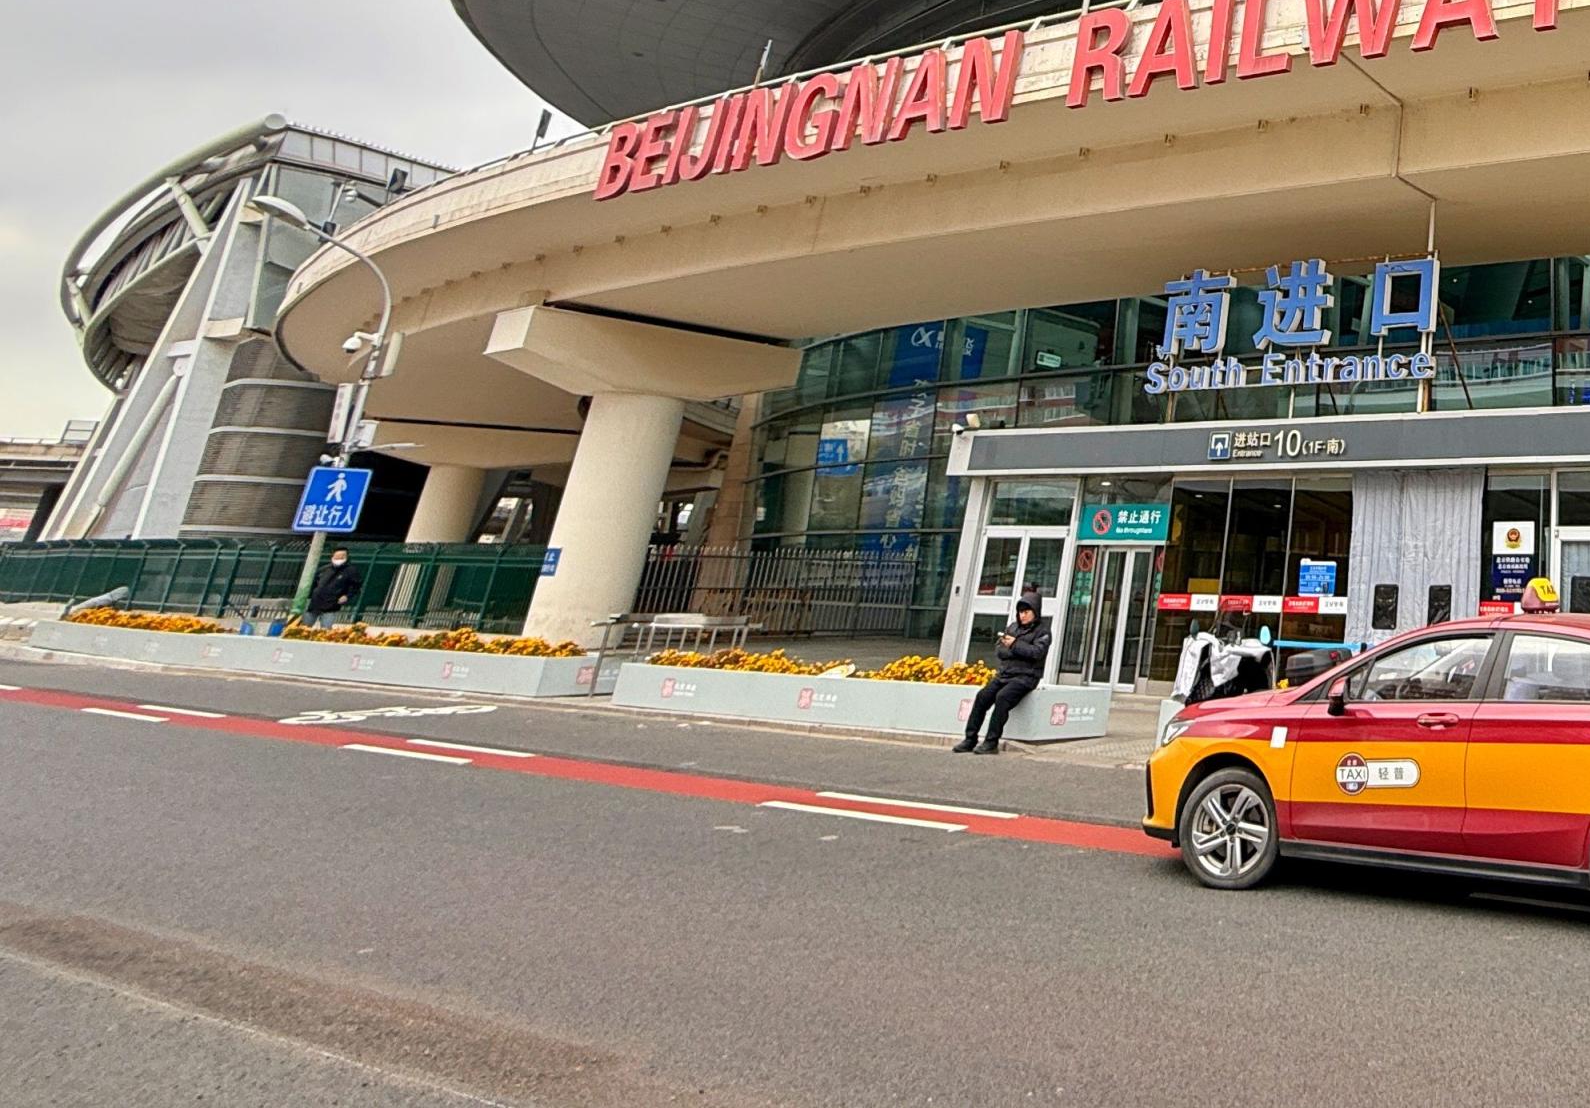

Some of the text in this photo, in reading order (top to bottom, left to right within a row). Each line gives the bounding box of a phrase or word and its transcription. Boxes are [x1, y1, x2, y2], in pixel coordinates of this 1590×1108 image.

[592, 29, 1025, 201] BEIJINGNAN
[1160, 258, 1441, 354] 南进口
[1144, 350, 1437, 394] South Entrance
[1233, 432, 1272, 448] 进站口
[1273, 429, 1301, 458] 10
[299, 504, 354, 526] 避让行人
[1117, 509, 1162, 525] 禁止通行
[1339, 768, 1367, 781] TAXI
